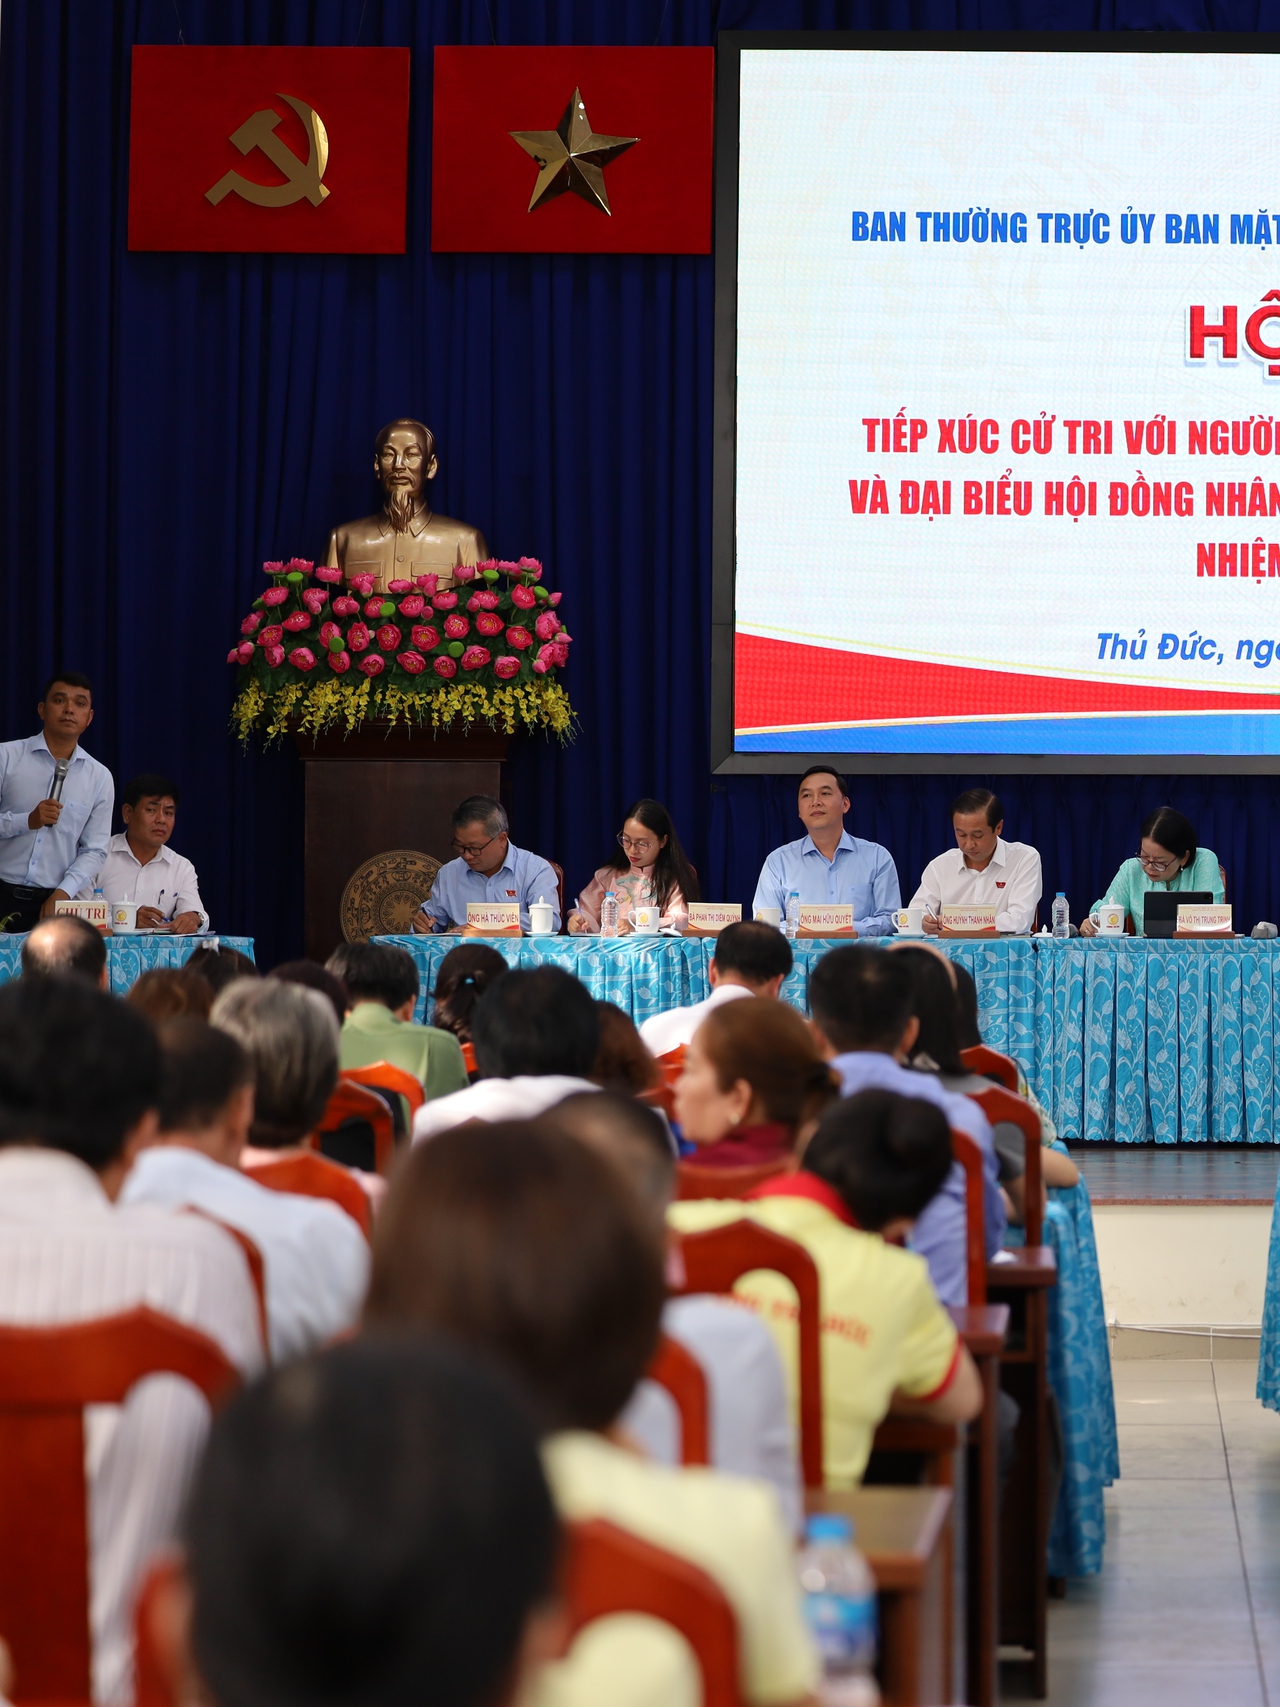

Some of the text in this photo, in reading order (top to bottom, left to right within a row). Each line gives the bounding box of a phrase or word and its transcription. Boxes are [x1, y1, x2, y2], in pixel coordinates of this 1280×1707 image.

[852, 211, 906, 242] BAN
[916, 207, 1027, 243] THƯỜNG
[1037, 209, 1110, 249] TRỰC
[1121, 206, 1155, 244] ỦY
[1165, 214, 1219, 244] BAN
[862, 407, 927, 452] TIẾP
[938, 414, 999, 454] XÚC
[1012, 411, 1056, 454] CỬ
[1064, 420, 1112, 454] TRI
[1124, 414, 1176, 455] VỚI
[849, 474, 889, 514] VÀ
[900, 480, 951, 521] ĐẠI
[964, 468, 1032, 516] BIỂU
[1045, 476, 1096, 522] HỘI
[1109, 470, 1193, 516] ĐỒNG
[1098, 629, 1147, 660] Thủ
[1158, 631, 1224, 665] Đức,
[86, 904, 106, 919] TRÌ
[468, 912, 480, 922] ÔNG
[481, 912, 489, 922] HÀ
[813, 915, 821, 924] MAI
[1201, 915, 1217, 924] TRUNG
